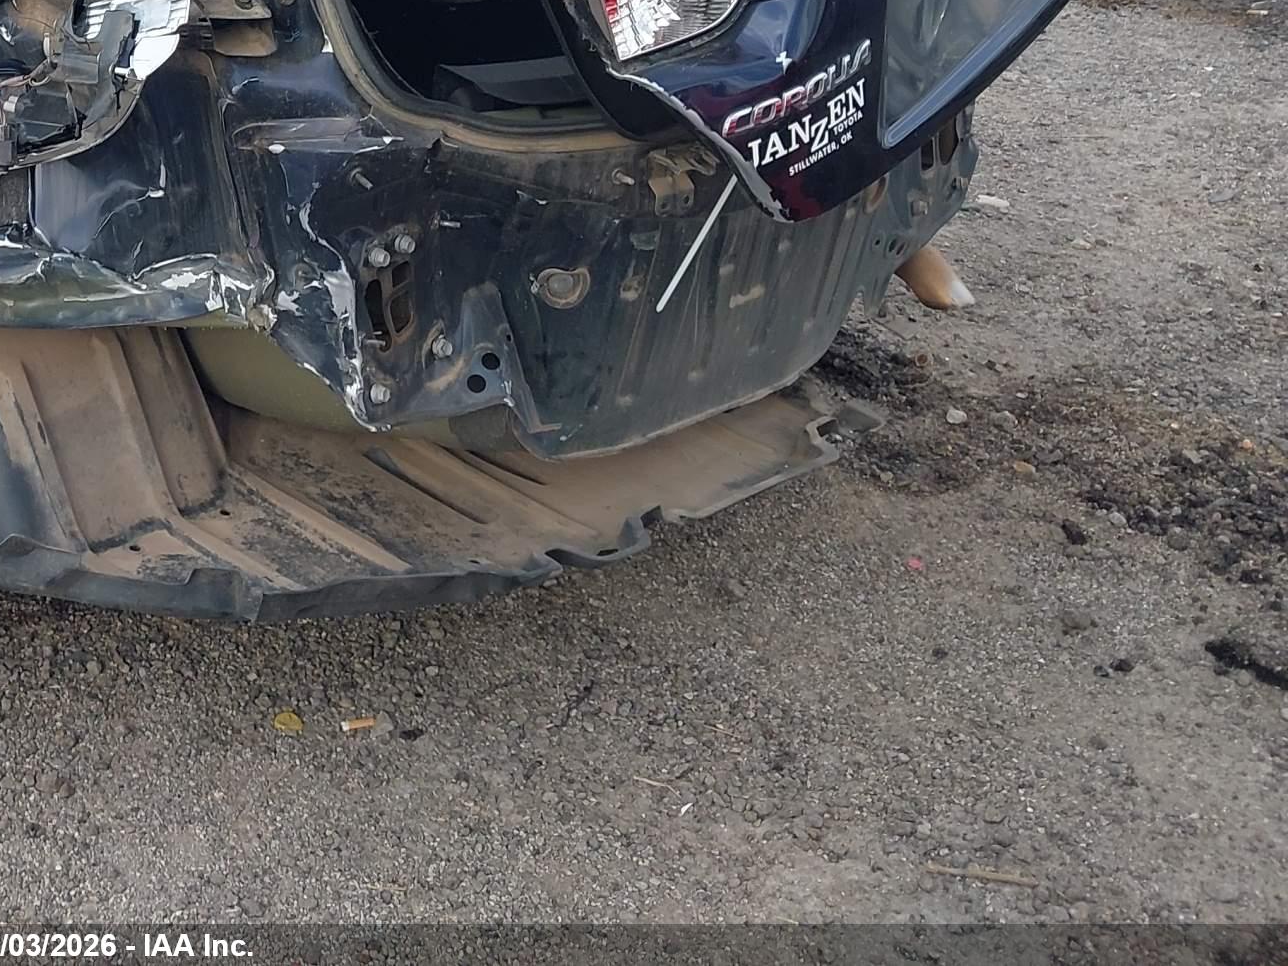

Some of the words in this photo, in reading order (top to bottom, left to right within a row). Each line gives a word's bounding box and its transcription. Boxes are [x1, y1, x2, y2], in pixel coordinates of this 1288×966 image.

[722, 39, 871, 137] COROLLA
[748, 78, 865, 168] JANZEN
[789, 141, 839, 176] STILLWATER,
[841, 131, 853, 145] OK
[833, 110, 863, 135] TOYOTA
